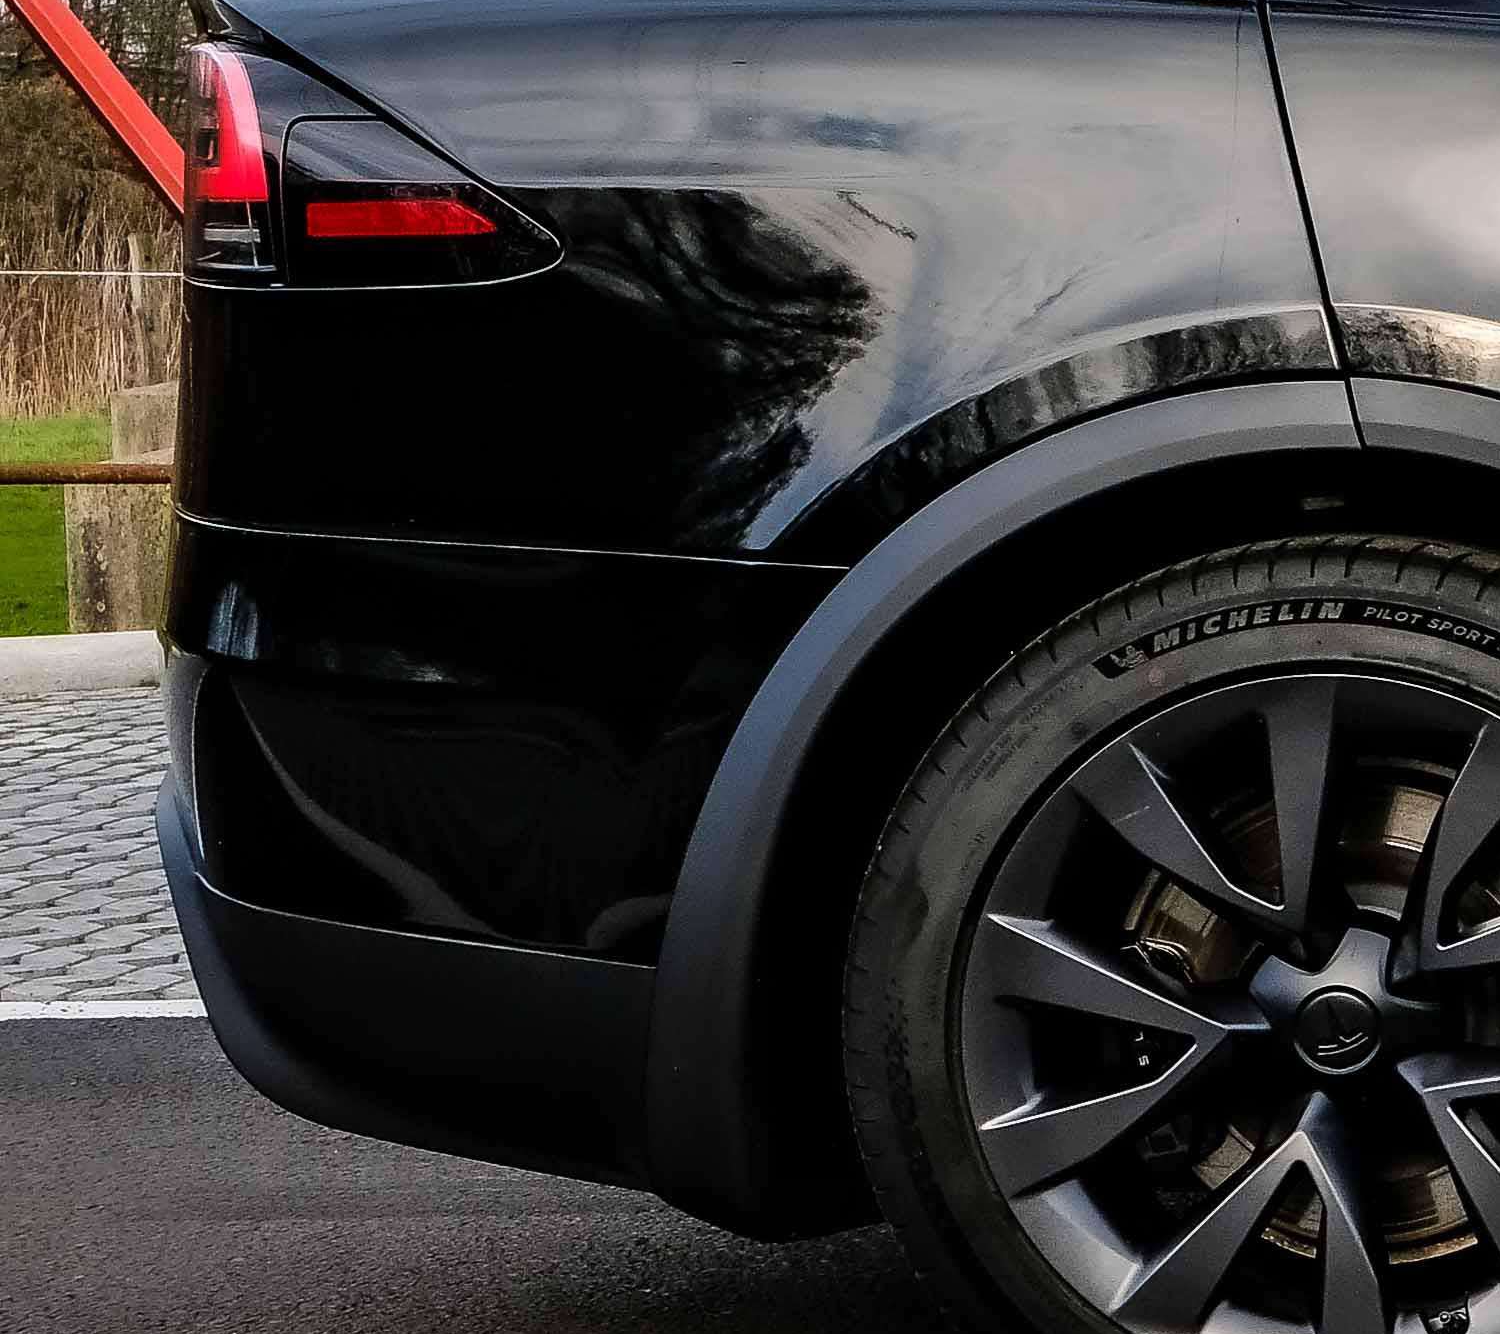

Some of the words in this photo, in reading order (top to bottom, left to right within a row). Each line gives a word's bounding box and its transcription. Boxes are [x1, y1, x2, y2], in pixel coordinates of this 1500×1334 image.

[1153, 602, 1345, 653] MICHELIN
[1363, 605, 1424, 624] PILOT
[1427, 617, 1496, 646] SPORT
